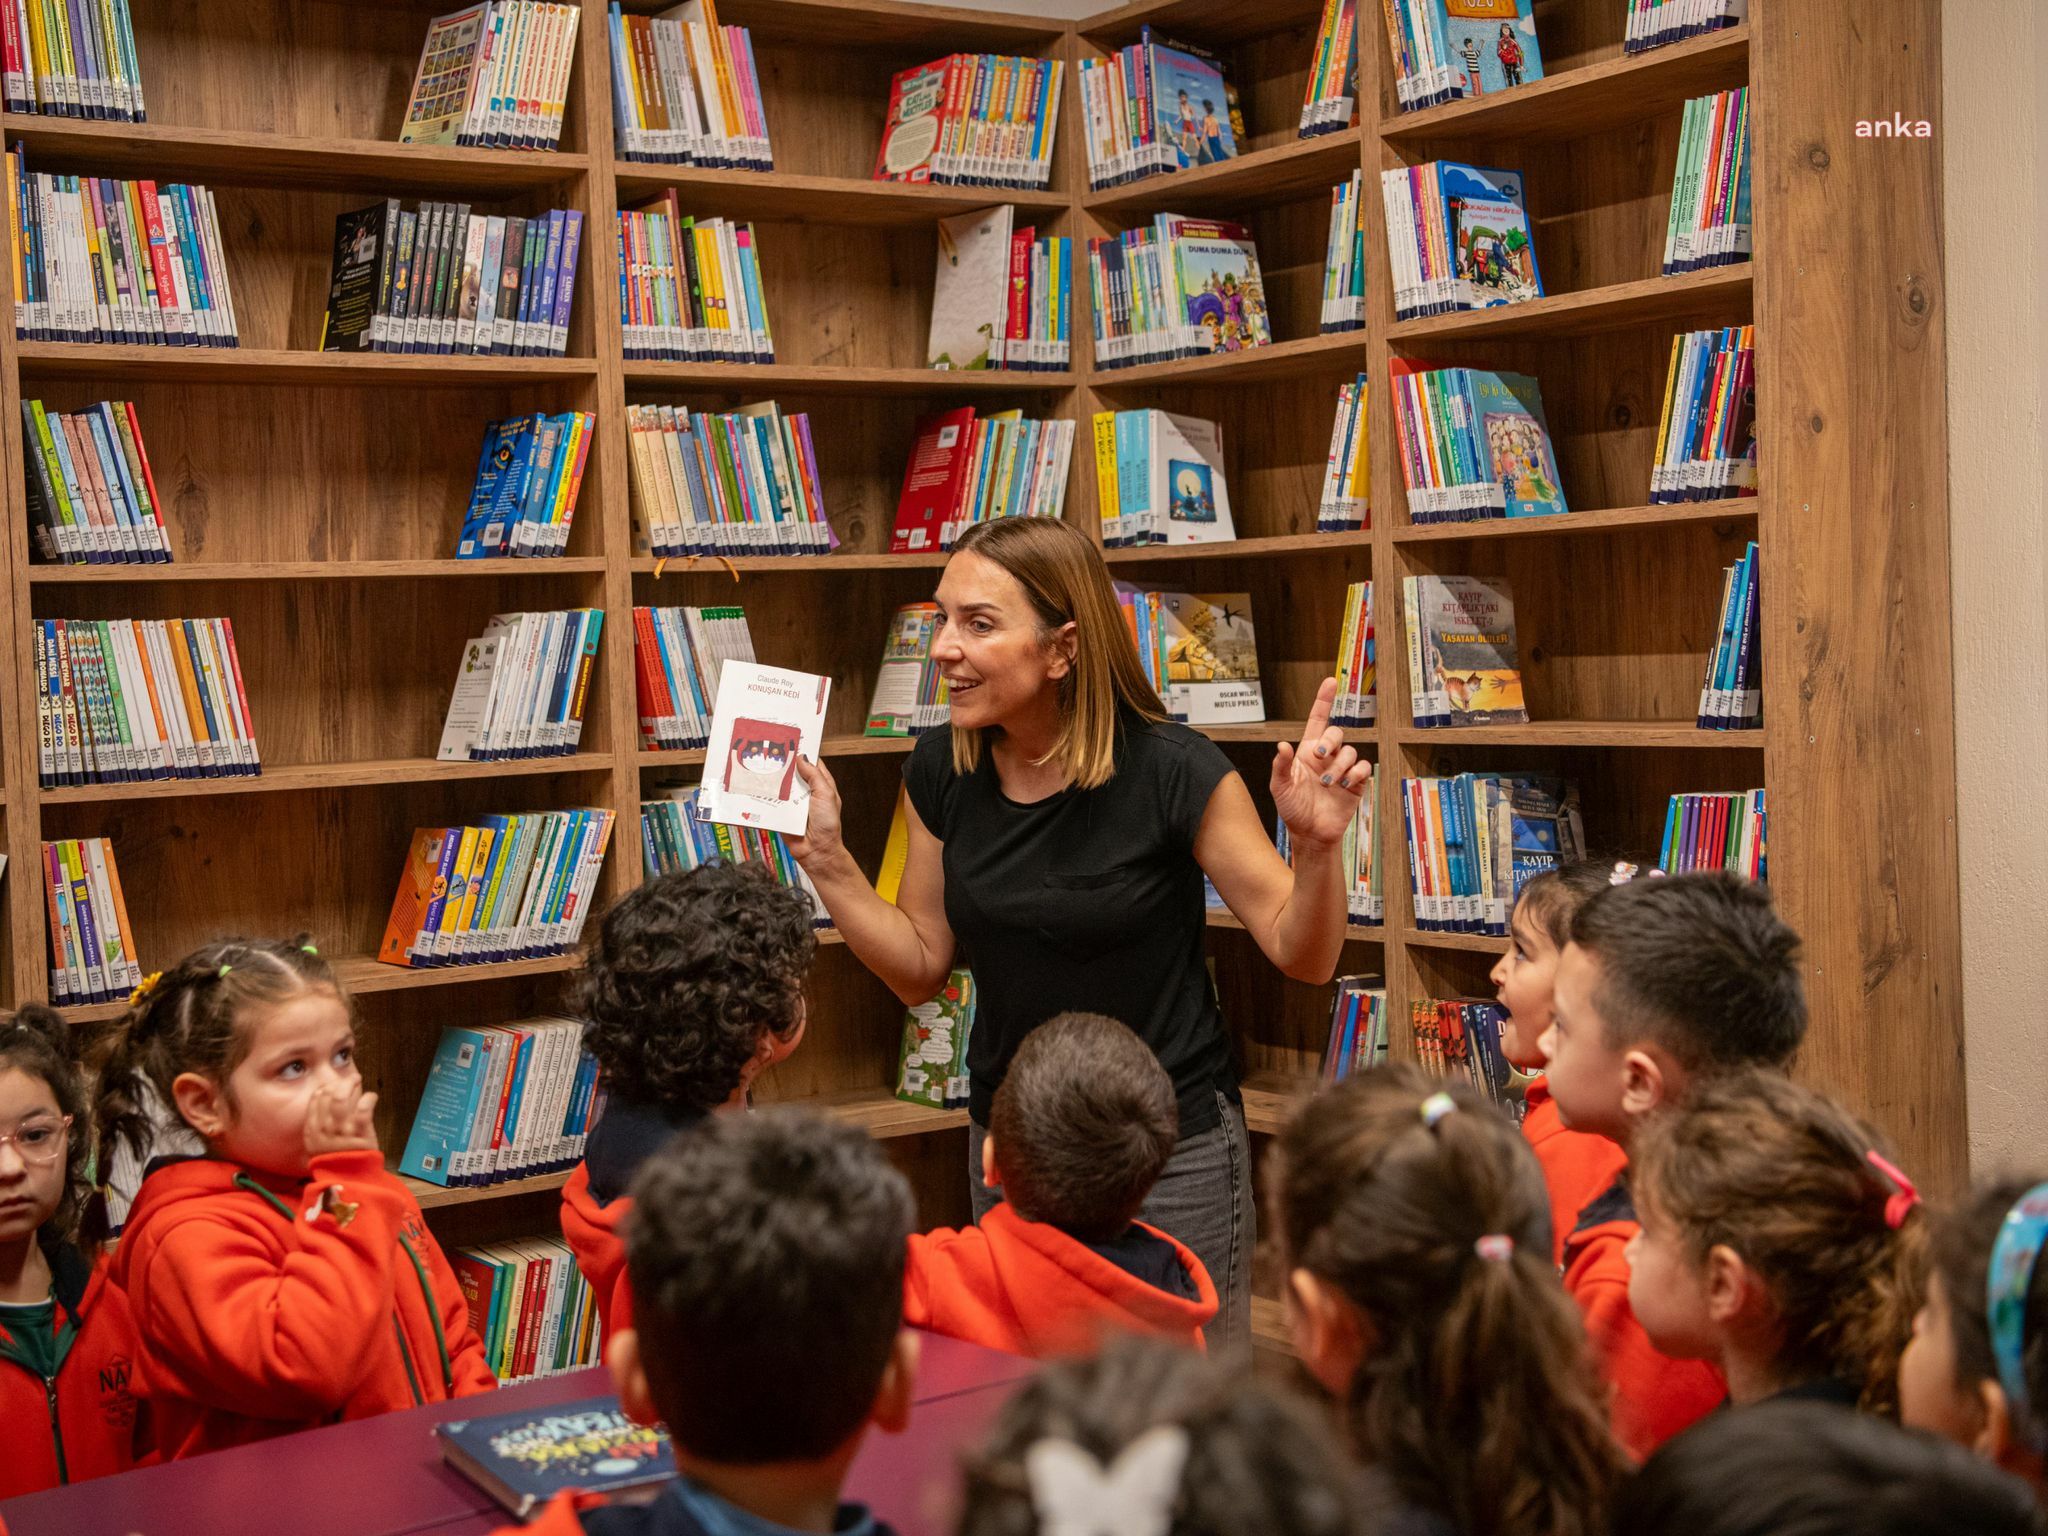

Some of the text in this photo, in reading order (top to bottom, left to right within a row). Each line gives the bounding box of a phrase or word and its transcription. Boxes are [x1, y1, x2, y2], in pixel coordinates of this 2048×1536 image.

[1188, 245, 1210, 254] DUMA
[1211, 247, 1233, 255] DUMA
[36, 626, 46, 660] KORKUSUZ
[1441, 632, 1476, 645] YAŞAYAN
[38, 661, 48, 692] RONALDO
[59, 659, 70, 687] NEYMAR
[757, 674, 794, 688] Claude Roy
[747, 683, 801, 699] KONUŞAN KEDİ
[1214, 699, 1259, 708] MUTLU PRENS
[1523, 855, 1554, 869] KAYIP
